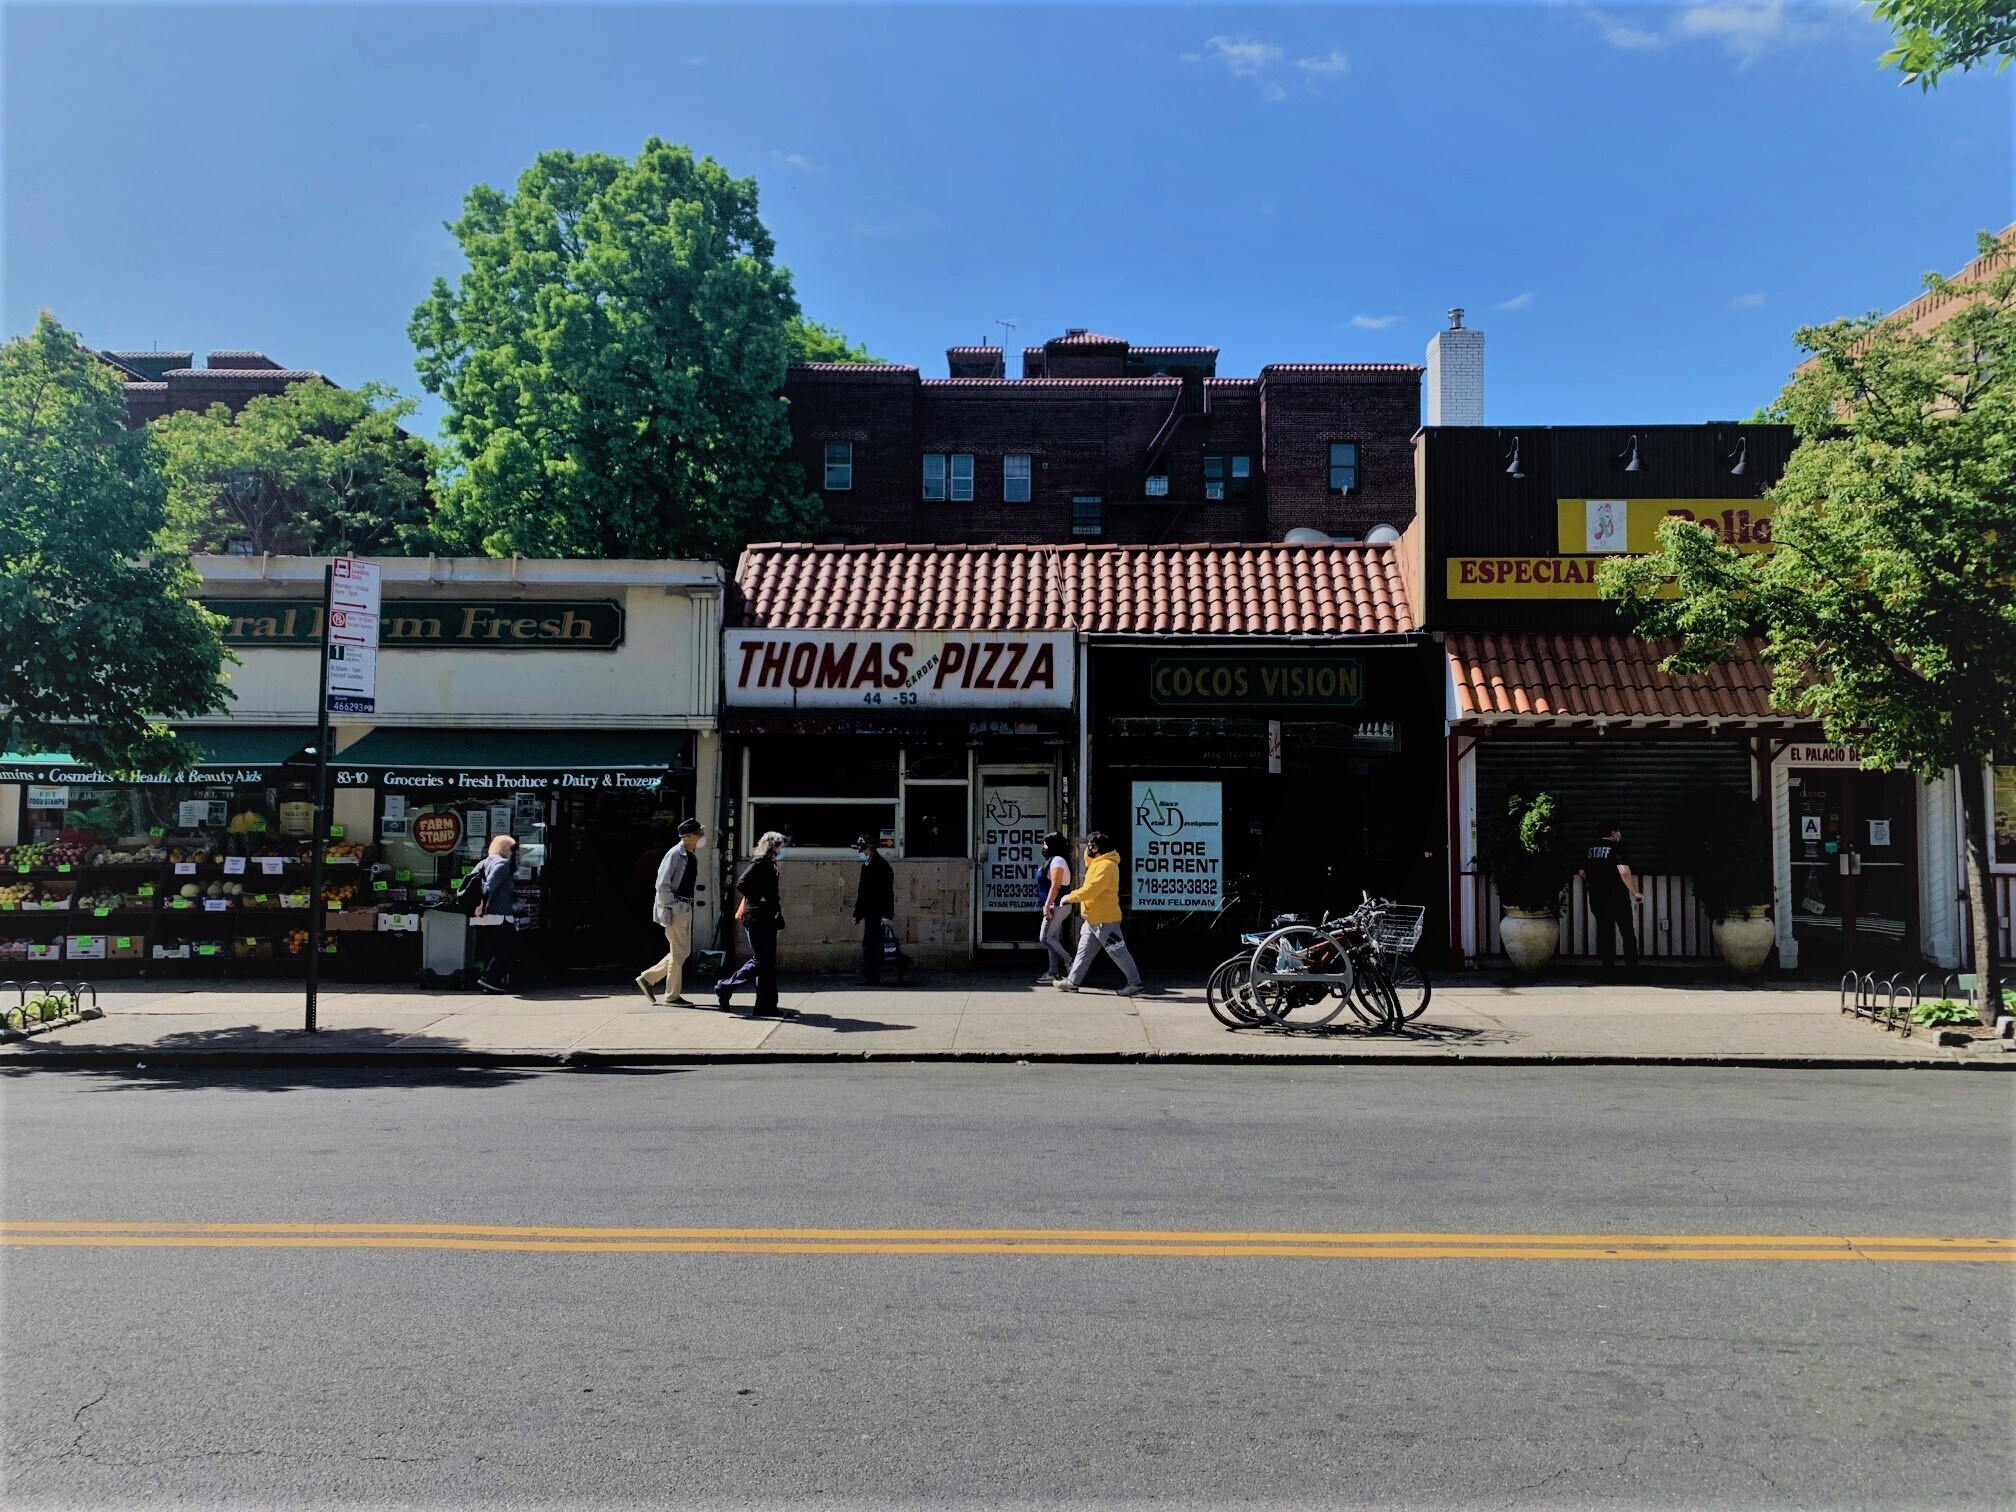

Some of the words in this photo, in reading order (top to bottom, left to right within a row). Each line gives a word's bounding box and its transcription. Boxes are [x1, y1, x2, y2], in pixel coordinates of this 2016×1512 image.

[1667, 509, 1772, 544] ollo
[351, 569, 370, 577] Loading
[456, 607, 594, 640] Fresh
[334, 645, 340, 659] 1
[738, 641, 914, 688] THOMAS
[933, 643, 1054, 689] PIZZA
[905, 654, 940, 689] GARDEN
[1156, 667, 1248, 697] COCOS
[1260, 667, 1358, 697] VISION
[863, 692, 881, 705] 44
[333, 701, 364, 712] 466293
[1791, 747, 1802, 761] EL
[1805, 747, 1846, 761] PALACIO
[0, 769, 35, 781] mins
[49, 768, 115, 783] Cosmetics
[175, 771, 186, 783] &
[188, 769, 235, 785] Beauty
[235, 769, 262, 783] Aids
[337, 771, 369, 784] 83-10
[383, 771, 444, 786] Groceries
[458, 773, 494, 788] Fresh
[496, 773, 548, 788] Produce
[562, 773, 599, 790] Dairy
[602, 774, 612, 787] &
[29, 798, 44, 806] FOOD
[44, 798, 65, 806] STAMPS
[420, 819, 454, 831] FARM
[1805, 819, 1818, 833] A
[419, 830, 455, 844] STAND
[987, 830, 1045, 845] STORE
[997, 847, 1033, 862] FOR
[1148, 841, 1206, 856] STORE
[1587, 846, 1612, 859] STAFF
[991, 865, 1039, 879] RENT
[1135, 858, 1169, 873] FOR
[1173, 858, 1219, 874] RENT
[1139, 898, 1166, 906] RYAN
[1168, 898, 1216, 907] FELDMAN
